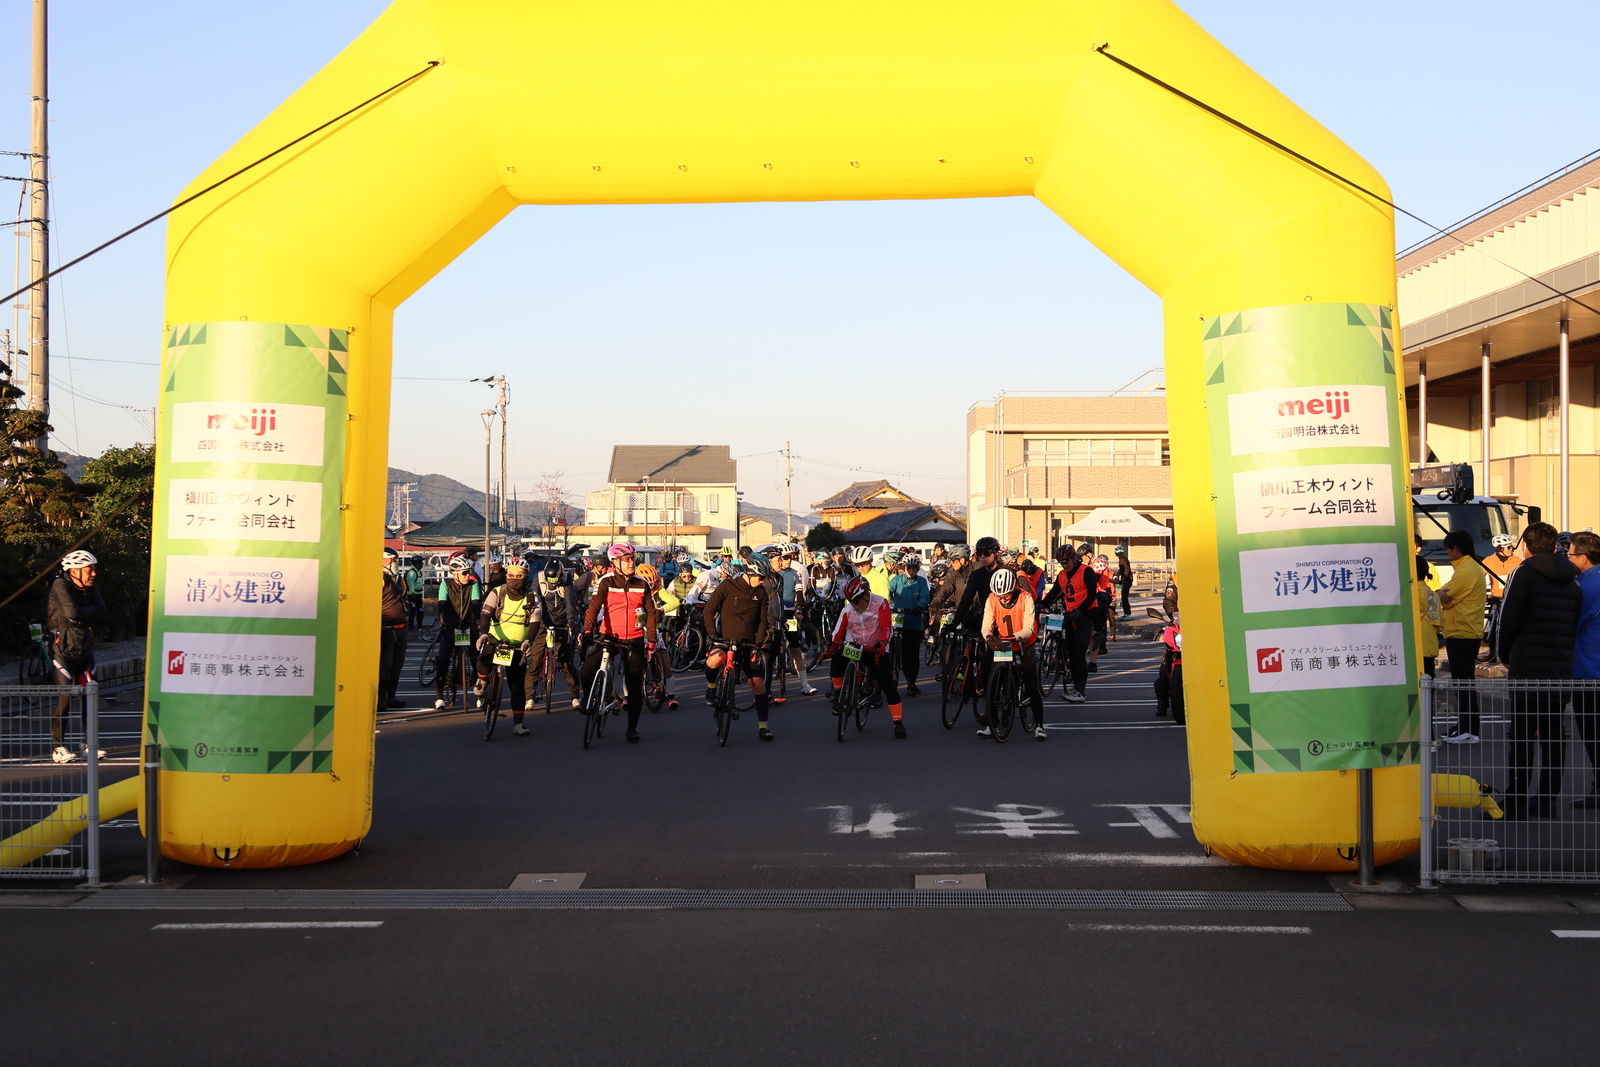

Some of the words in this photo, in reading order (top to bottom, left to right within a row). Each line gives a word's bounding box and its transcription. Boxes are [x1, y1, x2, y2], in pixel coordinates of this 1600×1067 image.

[1278, 391, 1350, 420] meiji
[207, 408, 276, 436] meiji
[1269, 423, 1360, 439] 四国明治株式会社
[198, 440, 285, 452] 四国株式会社
[1262, 498, 1377, 519] ファーム合同会社
[186, 513, 296, 529] ファー合同会社
[1321, 559, 1362, 567] CORPORATION
[1273, 567, 1378, 597] 清水建設
[187, 578, 286, 604] 清水建設
[1002, 615, 1014, 637] 1
[191, 653, 298, 662] アイスクリームコミュニケーション
[845, 649, 860, 659] 005
[1290, 644, 1393, 655] アイスクリームコミュニケーション
[190, 662, 305, 678] 南商事株式会社
[1289, 653, 1399, 671] 南商事株式会社
